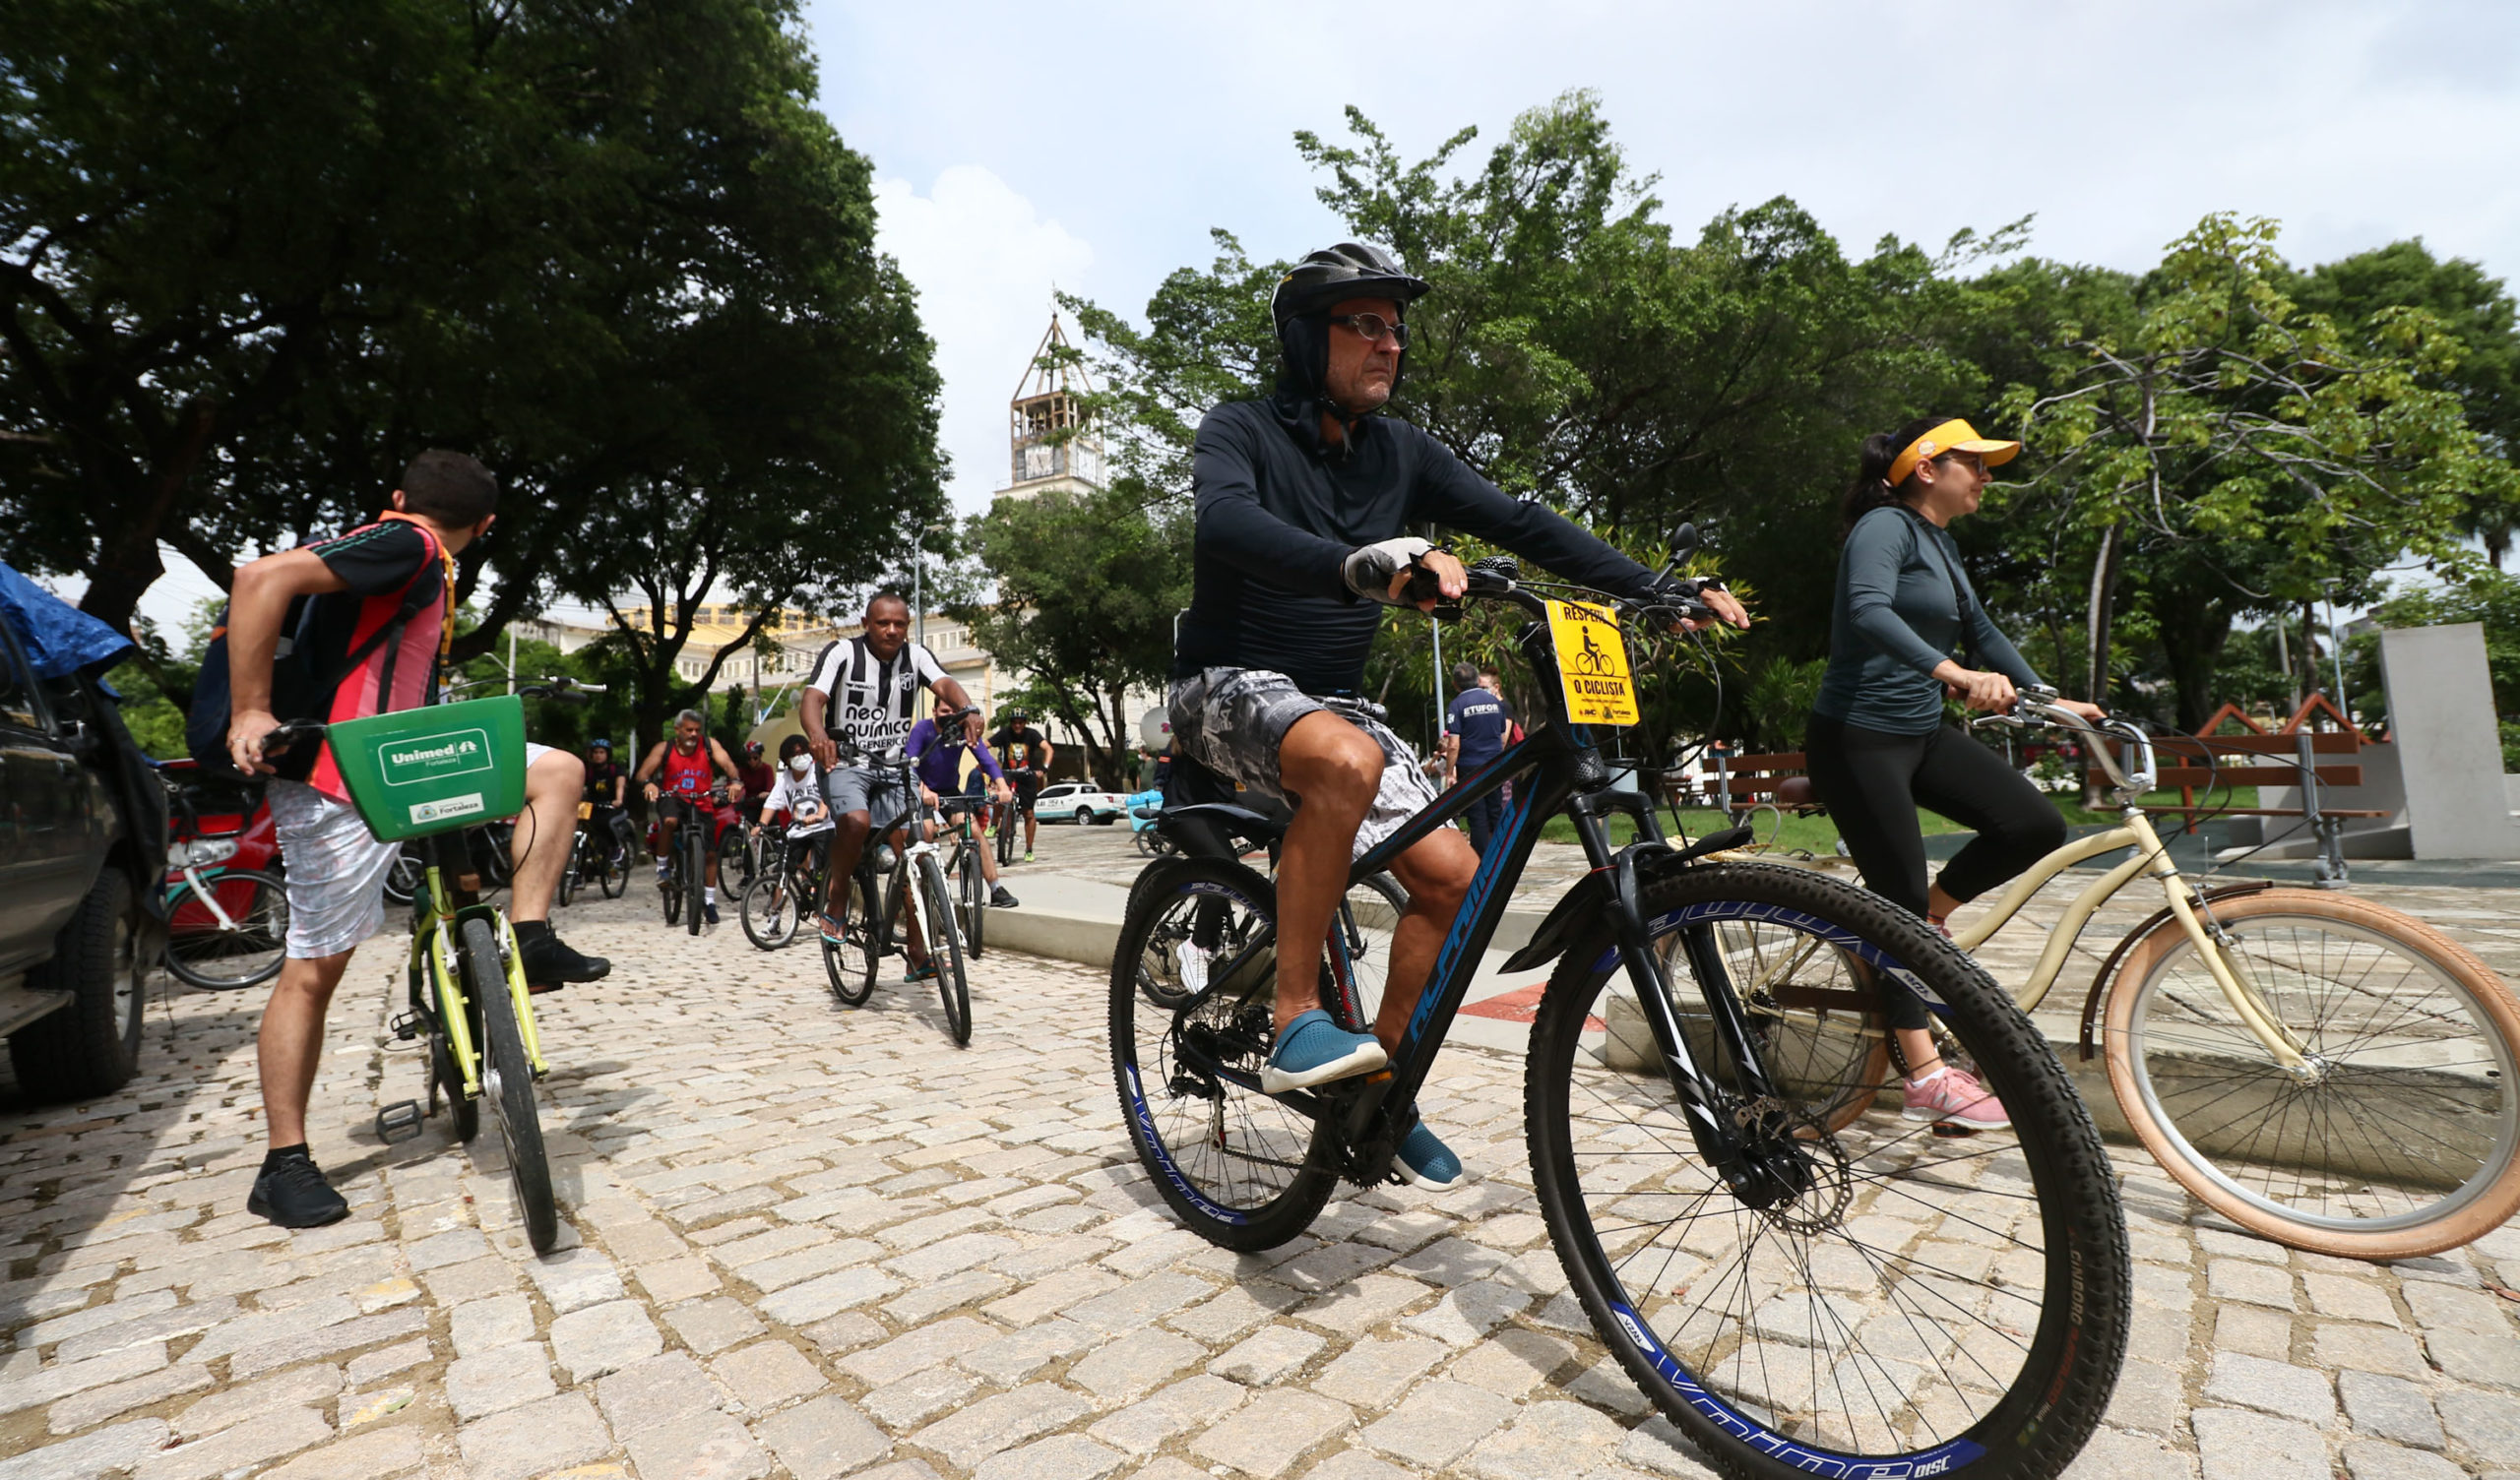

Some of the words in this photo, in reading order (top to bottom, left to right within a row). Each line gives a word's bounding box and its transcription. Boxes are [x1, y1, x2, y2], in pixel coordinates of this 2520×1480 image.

[1574, 679, 1582, 694] O
[1584, 679, 1625, 696] CICLISTA
[845, 706, 884, 720] neo
[1463, 704, 1499, 716] ETUFOR
[391, 744, 455, 764] Unimed
[425, 757, 457, 767] Fortaleza
[439, 802, 478, 814] Fortaleza
[1624, 1319, 1643, 1344] VZAN
[1914, 1454, 1952, 1479] DISC
